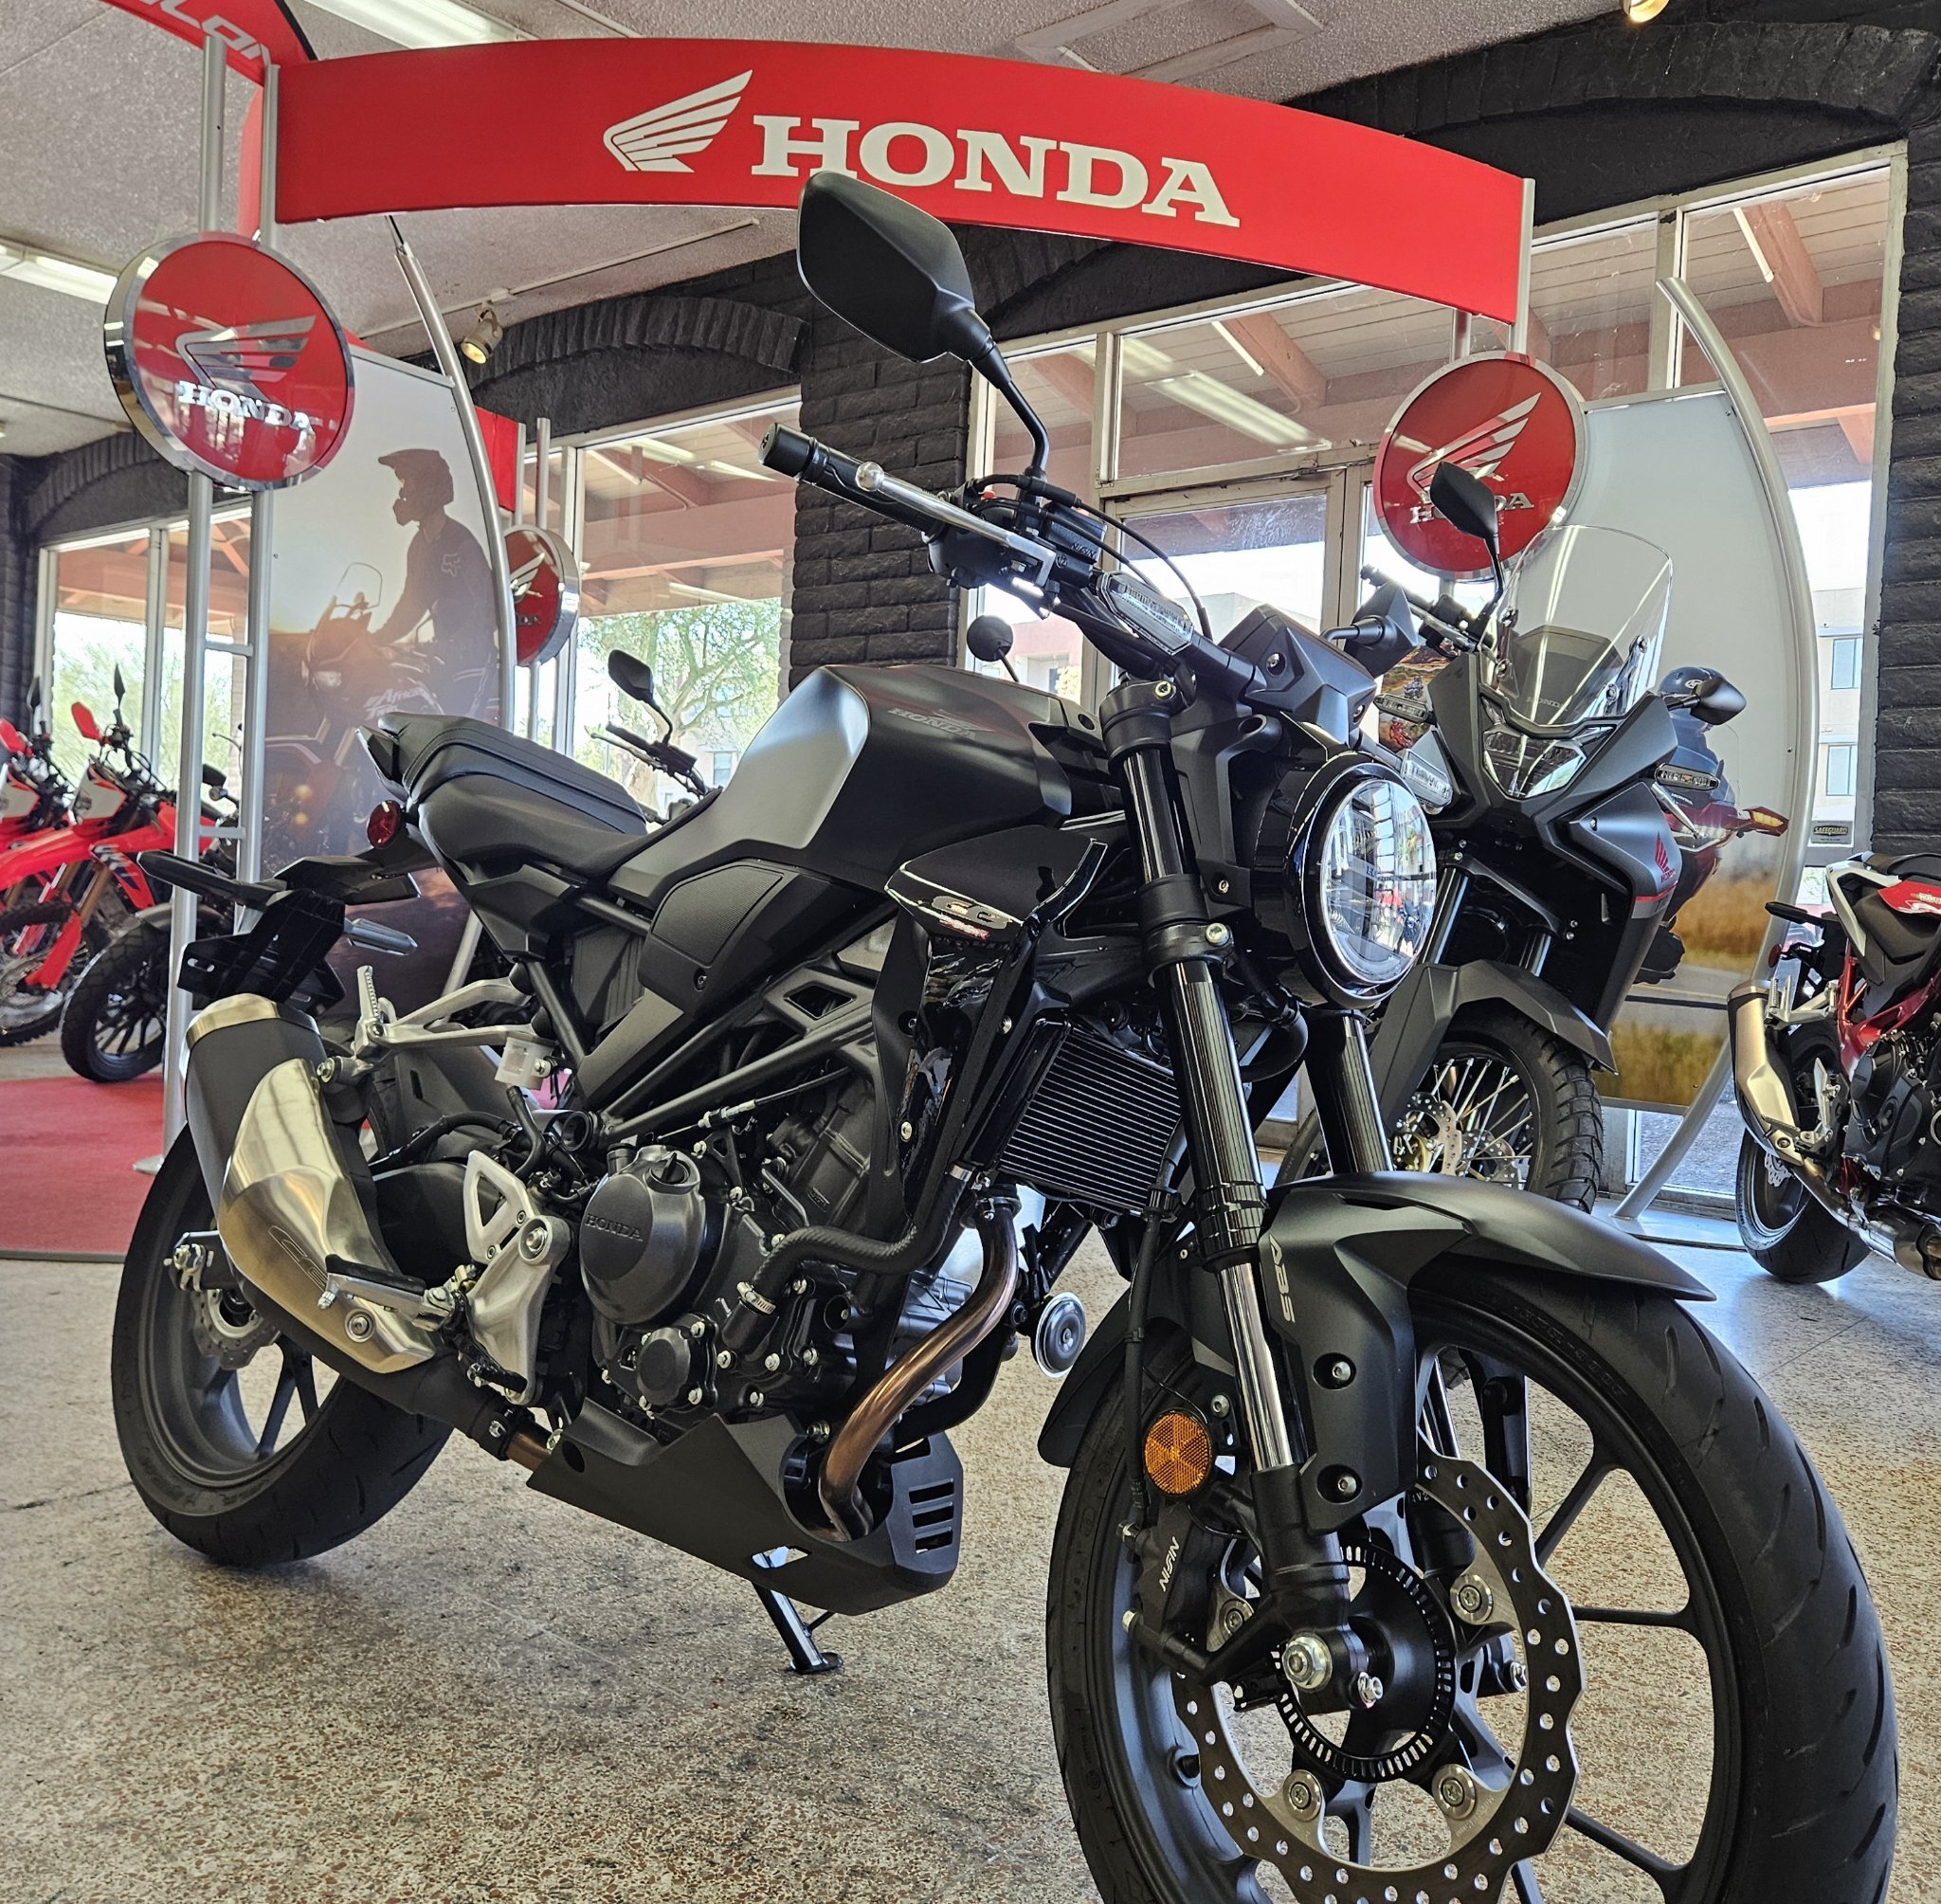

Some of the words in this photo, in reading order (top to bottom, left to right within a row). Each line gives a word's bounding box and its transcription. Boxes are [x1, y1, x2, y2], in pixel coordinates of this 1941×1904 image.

[752, 115, 1241, 227] HONDA
[176, 380, 315, 438] HONDA
[887, 707, 976, 740] HONDA
[584, 1213, 644, 1242] HONDA
[1269, 1234, 1296, 1323] ABS
